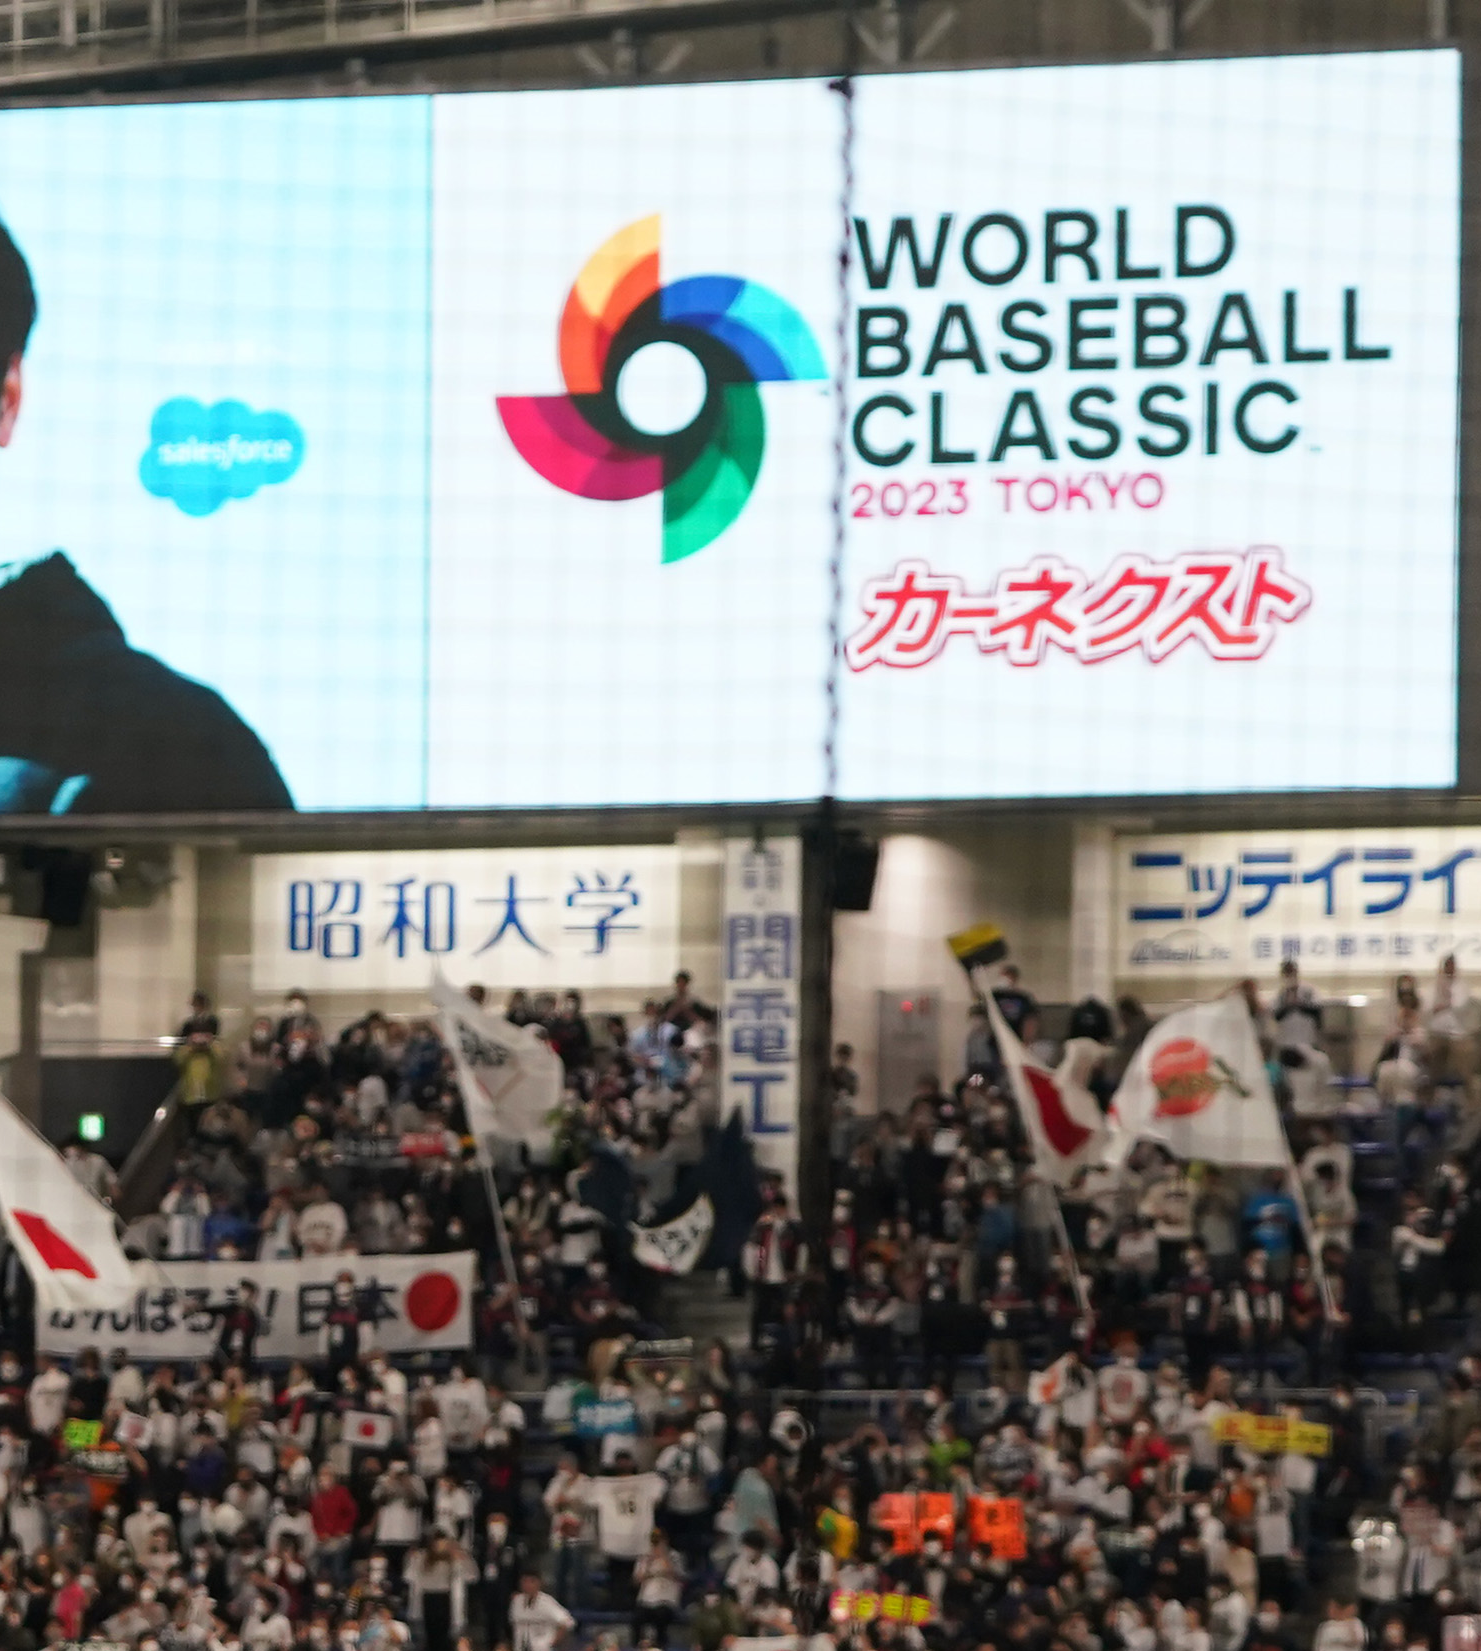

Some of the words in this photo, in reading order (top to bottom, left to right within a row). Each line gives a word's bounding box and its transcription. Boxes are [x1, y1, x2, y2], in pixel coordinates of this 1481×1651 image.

[852, 204, 1236, 290] WORLD
[857, 287, 1391, 378] BASEBALL
[157, 433, 294, 470] salesforce
[851, 380, 1301, 467] CLASSIC
[851, 479, 969, 518] 2023
[994, 472, 1165, 513] TOKYO
[845, 545, 1312, 672] カーネクスト
[289, 871, 641, 959] 昭和大学
[1129, 848, 1477, 920] ニッテイライ
